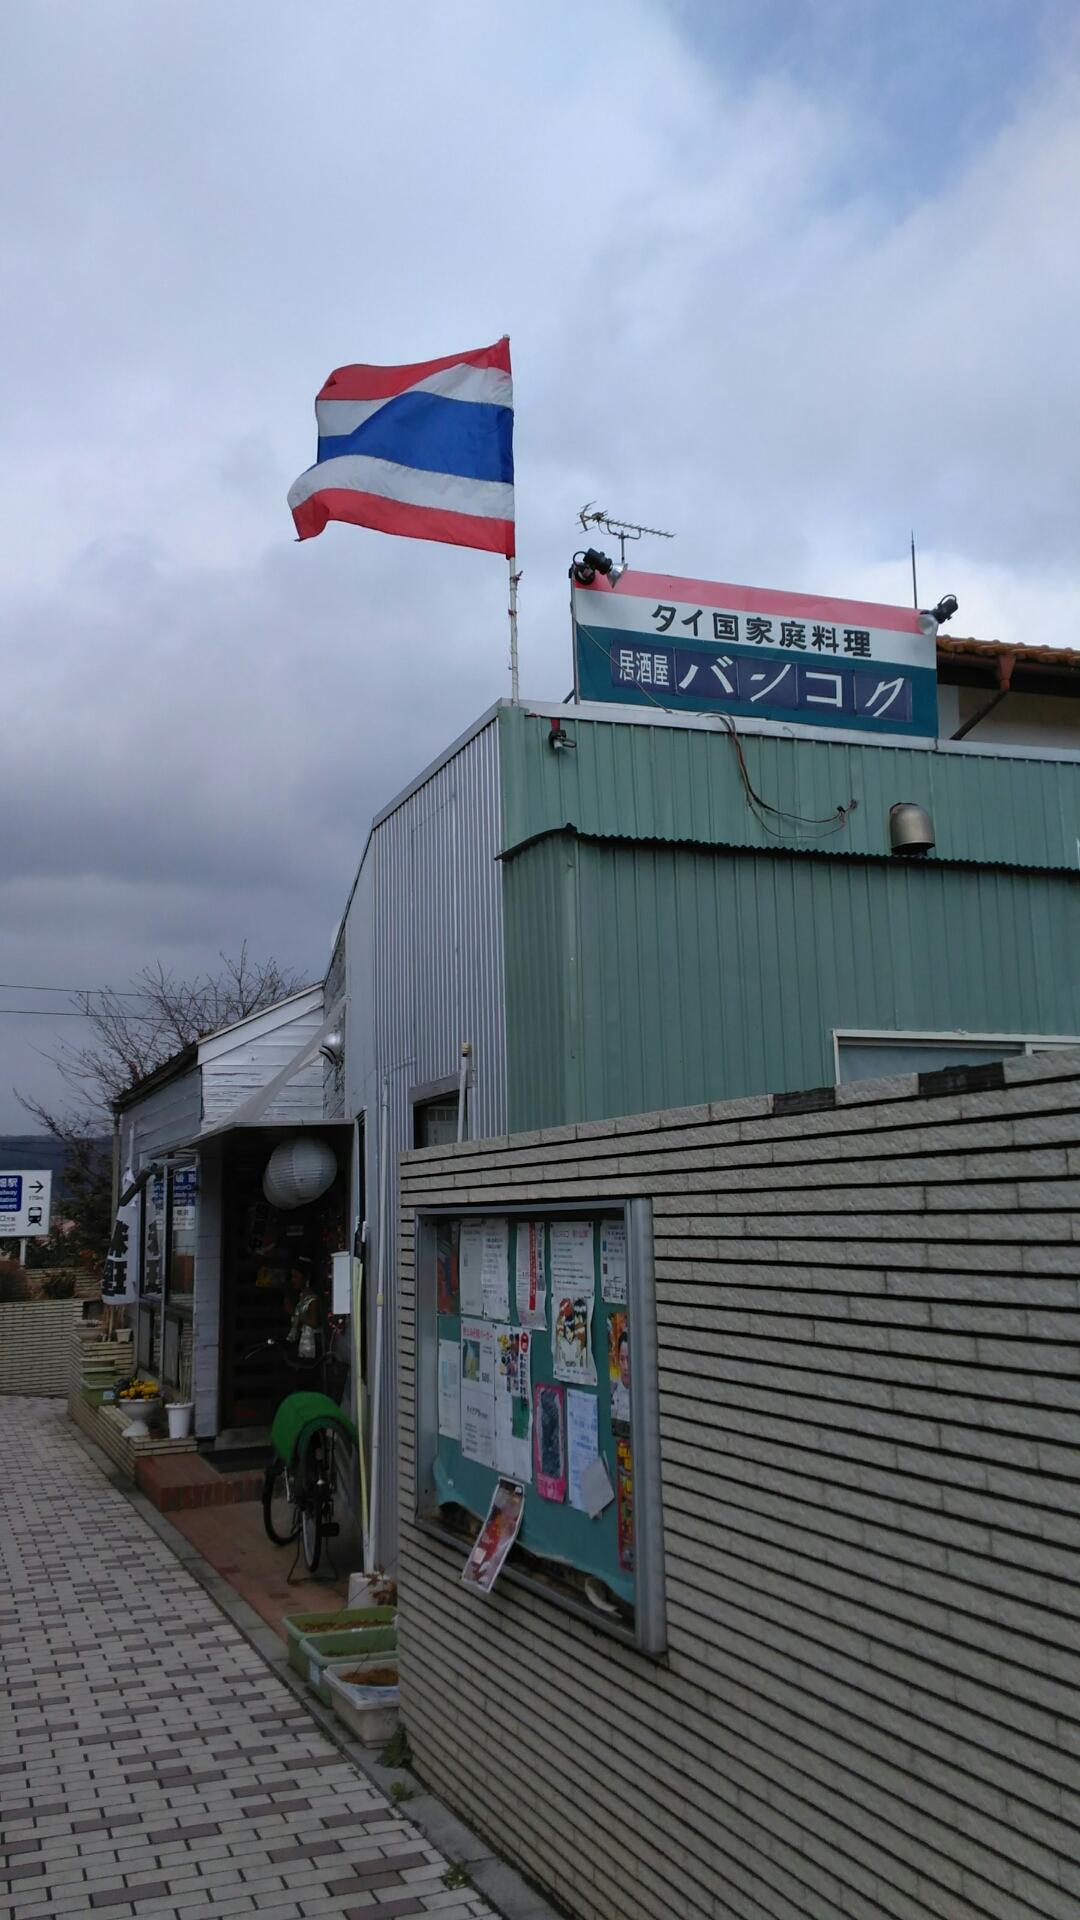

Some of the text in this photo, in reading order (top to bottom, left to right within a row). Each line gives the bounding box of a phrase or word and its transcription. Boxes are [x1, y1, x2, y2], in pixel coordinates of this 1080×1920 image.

[651, 604, 872, 658] タイ国家庭料理
[619, 649, 905, 717] 居酒屋 バンコク
